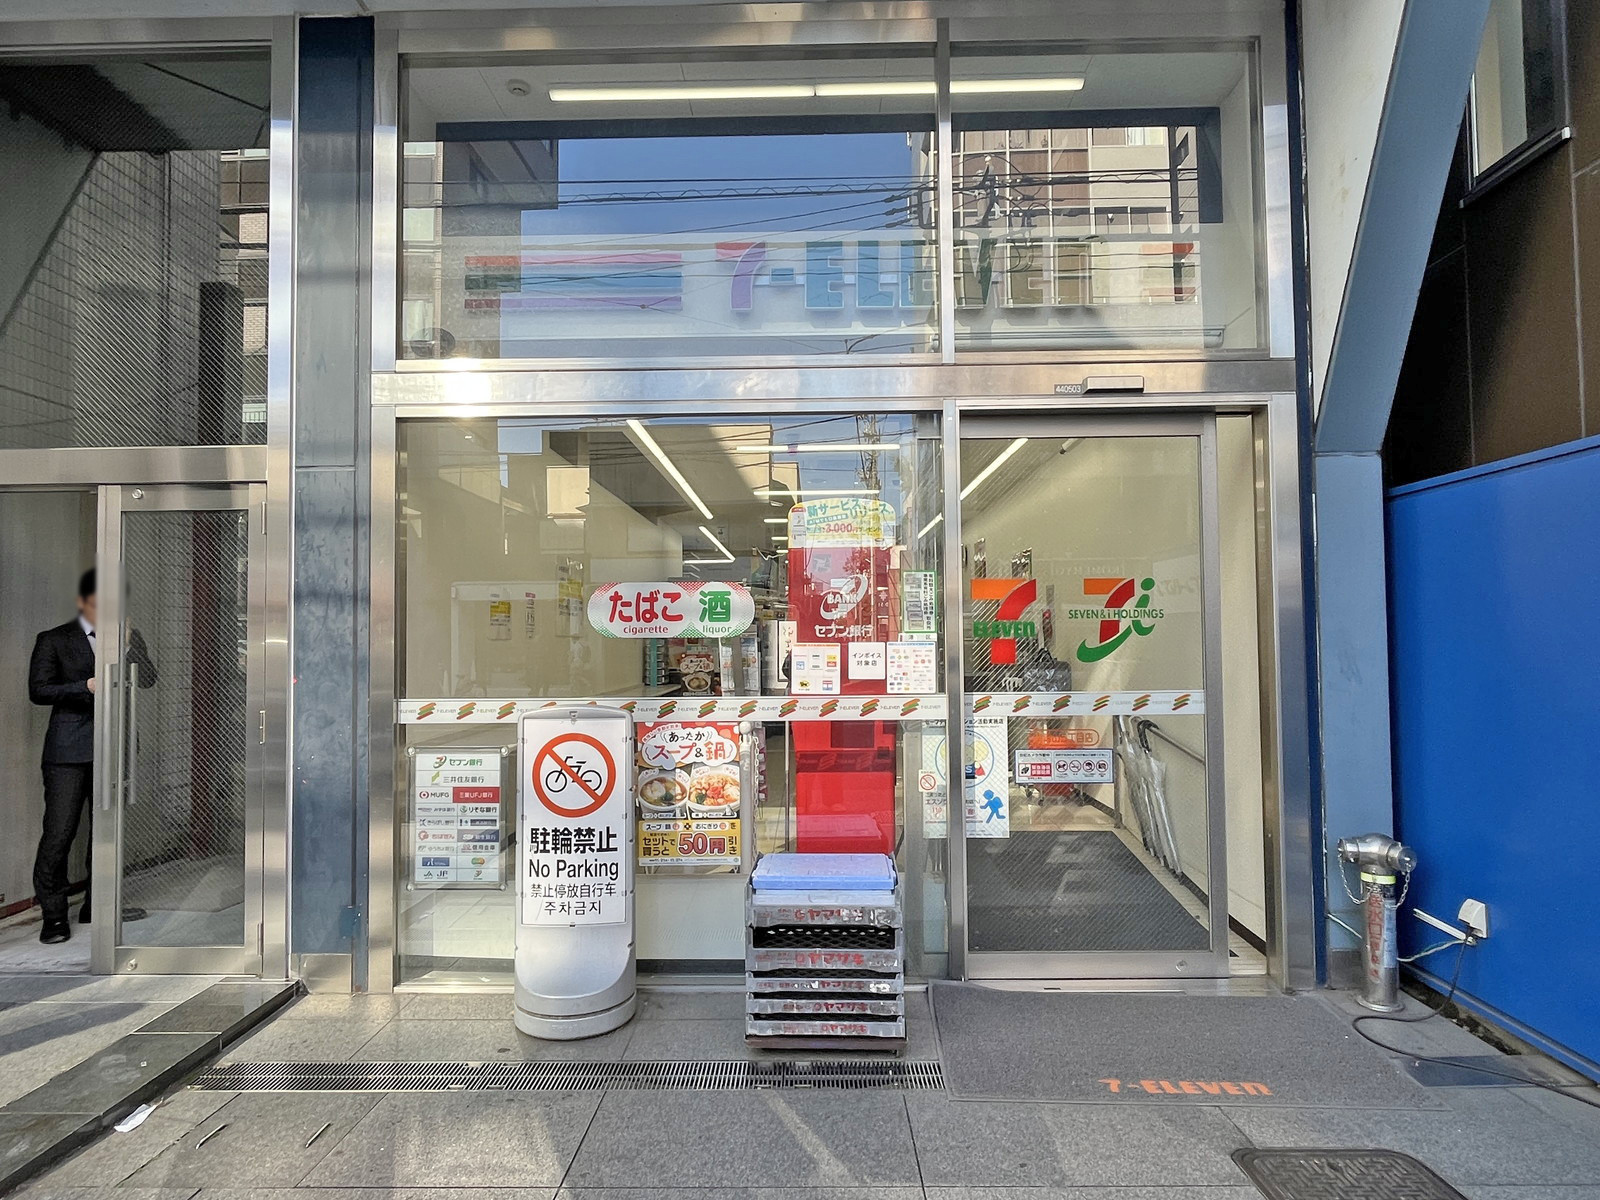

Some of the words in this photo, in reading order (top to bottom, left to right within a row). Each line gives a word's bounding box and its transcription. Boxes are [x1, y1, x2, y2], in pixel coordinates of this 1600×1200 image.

[1056, 385, 1081, 393] 440503
[609, 589, 684, 623] たばこ
[699, 590, 732, 623] 酒
[827, 593, 857, 604] BANK
[1114, 608, 1165, 620] HOLDINGS
[623, 625, 669, 634] cigarette
[702, 624, 732, 634] liquor
[814, 624, 873, 638] セブン銀行
[668, 731, 705, 742] あったか
[652, 741, 726, 760] スープ&鍋
[530, 826, 618, 854] 駐輪禁止
[643, 837, 676, 846] セットで
[678, 832, 726, 855] 50円
[728, 836, 738, 855] 引き
[643, 846, 670, 856] 買うと
[529, 858, 550, 878] No
[556, 858, 619, 880] Parking
[530, 882, 617, 899] 禁止停放自行车
[544, 900, 602, 916] 주차금지
